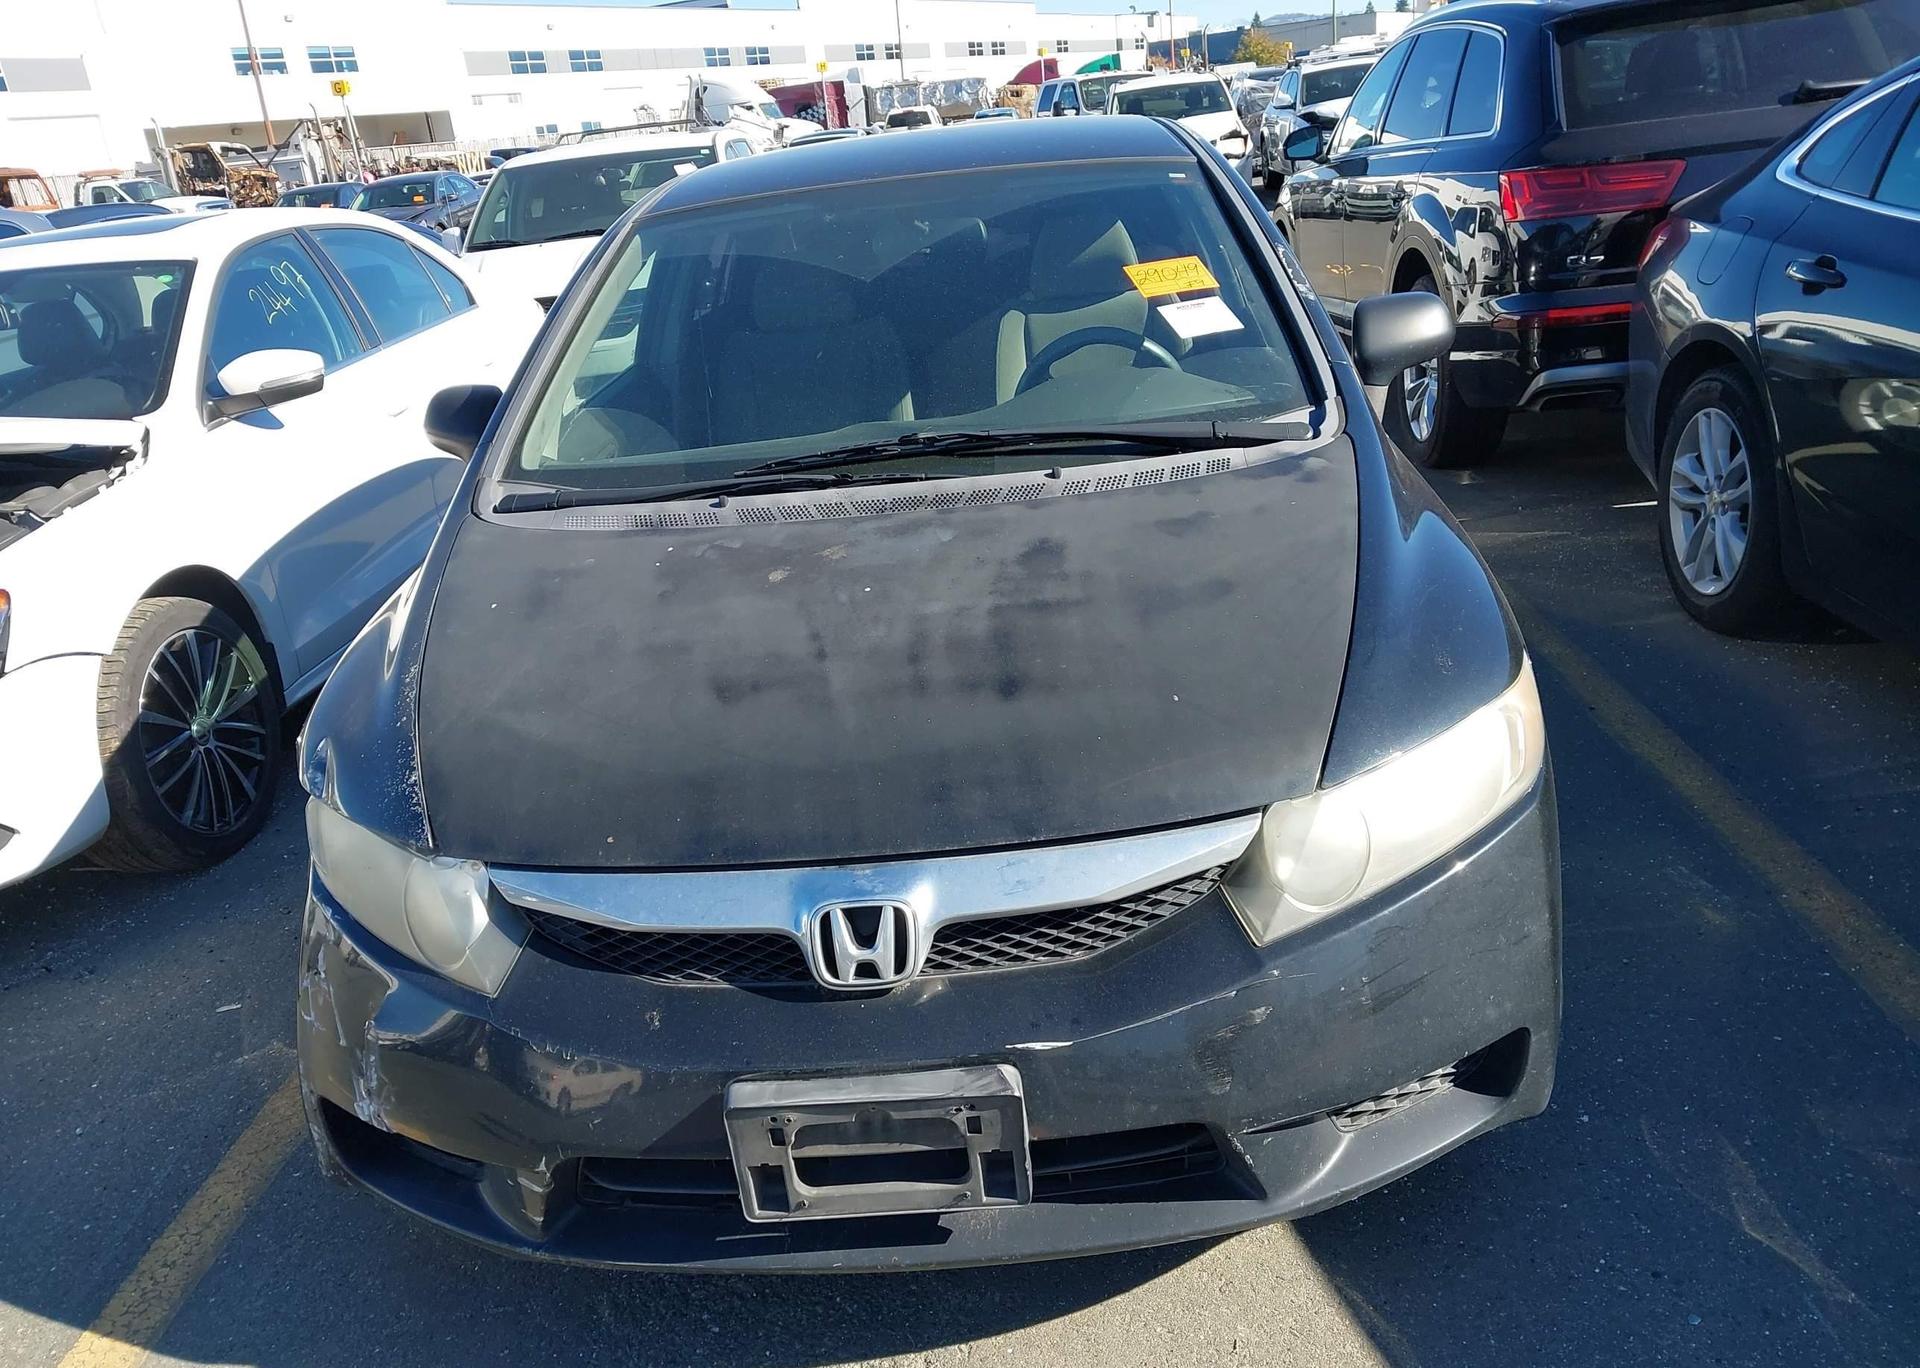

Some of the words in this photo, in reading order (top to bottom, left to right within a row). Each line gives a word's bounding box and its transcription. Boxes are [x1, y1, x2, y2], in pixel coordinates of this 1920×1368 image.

[334, 82, 342, 93] G
[1566, 255, 1605, 267] Q7
[1136, 263, 1200, 286] 29049
